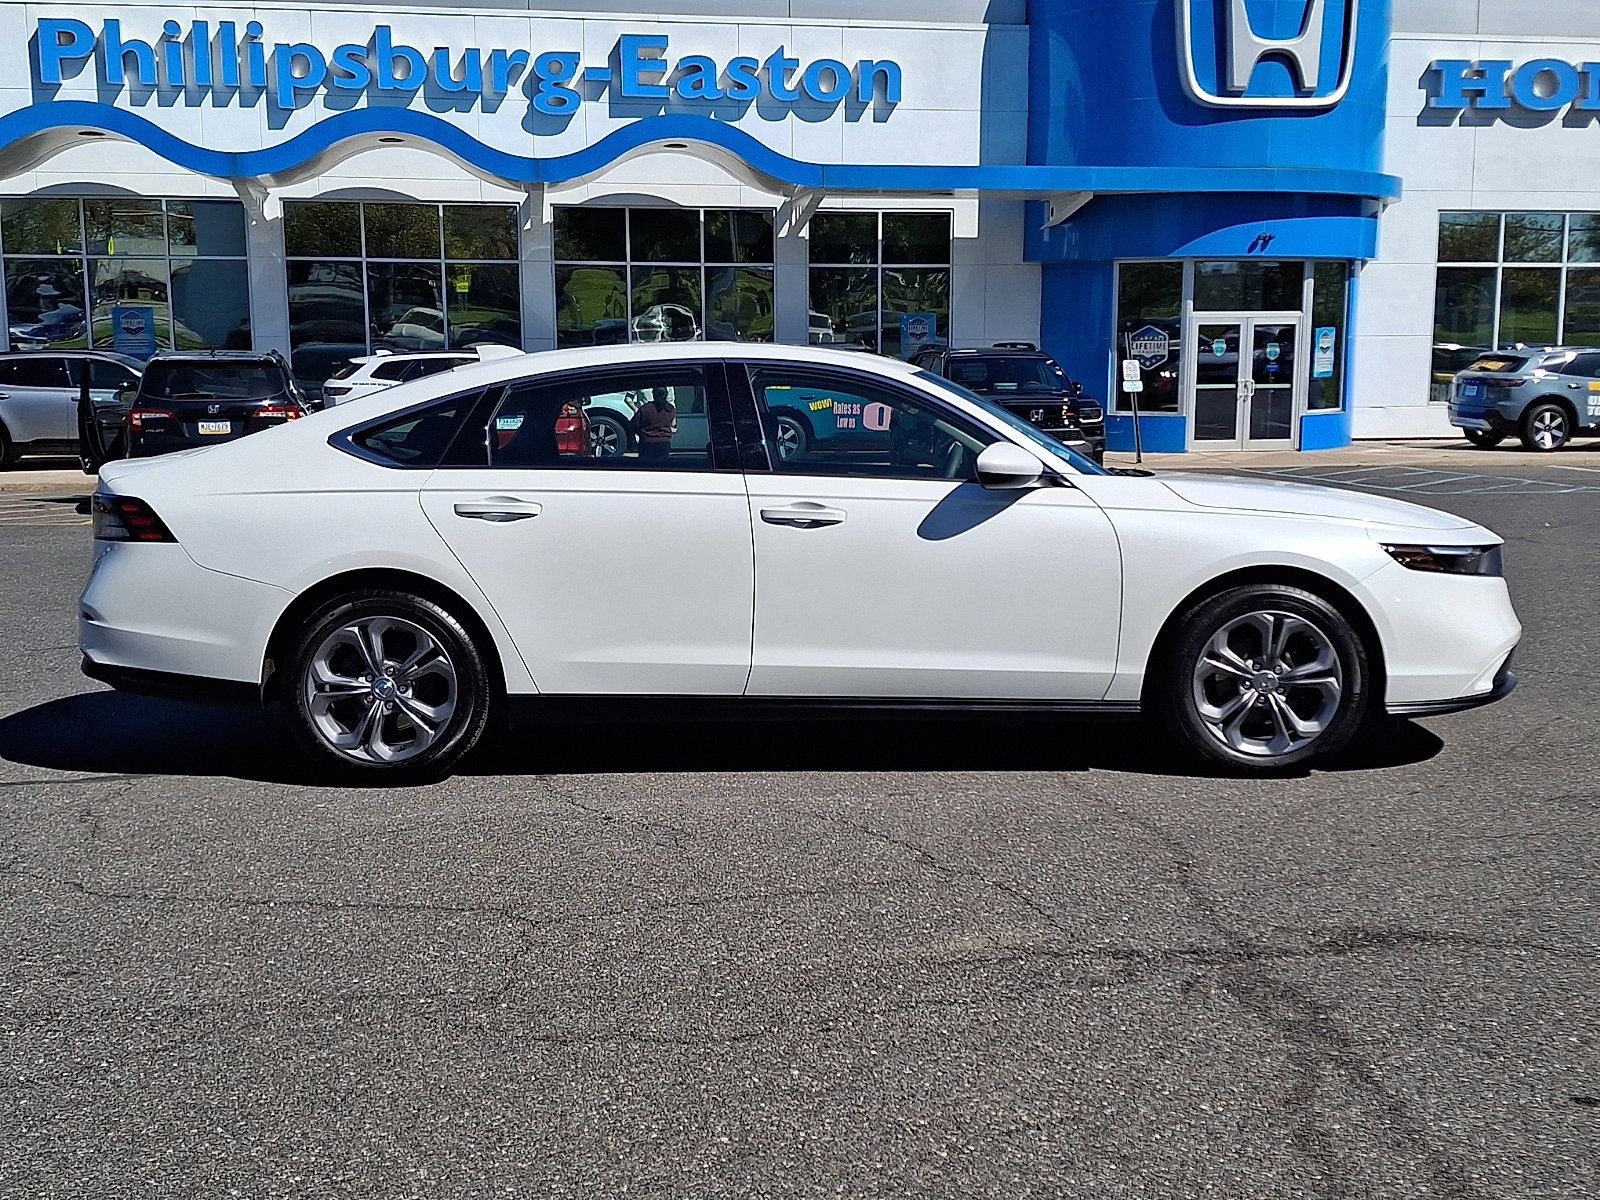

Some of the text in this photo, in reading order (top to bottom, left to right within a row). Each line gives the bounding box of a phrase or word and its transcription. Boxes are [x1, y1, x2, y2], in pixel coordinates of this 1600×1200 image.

[37, 18, 902, 115] Phillipsburg-Easton
[1428, 58, 1600, 111] HO
[1130, 342, 1167, 351] LIFETIME
[833, 401, 861, 415] Rates as
[836, 415, 856, 428] Low as
